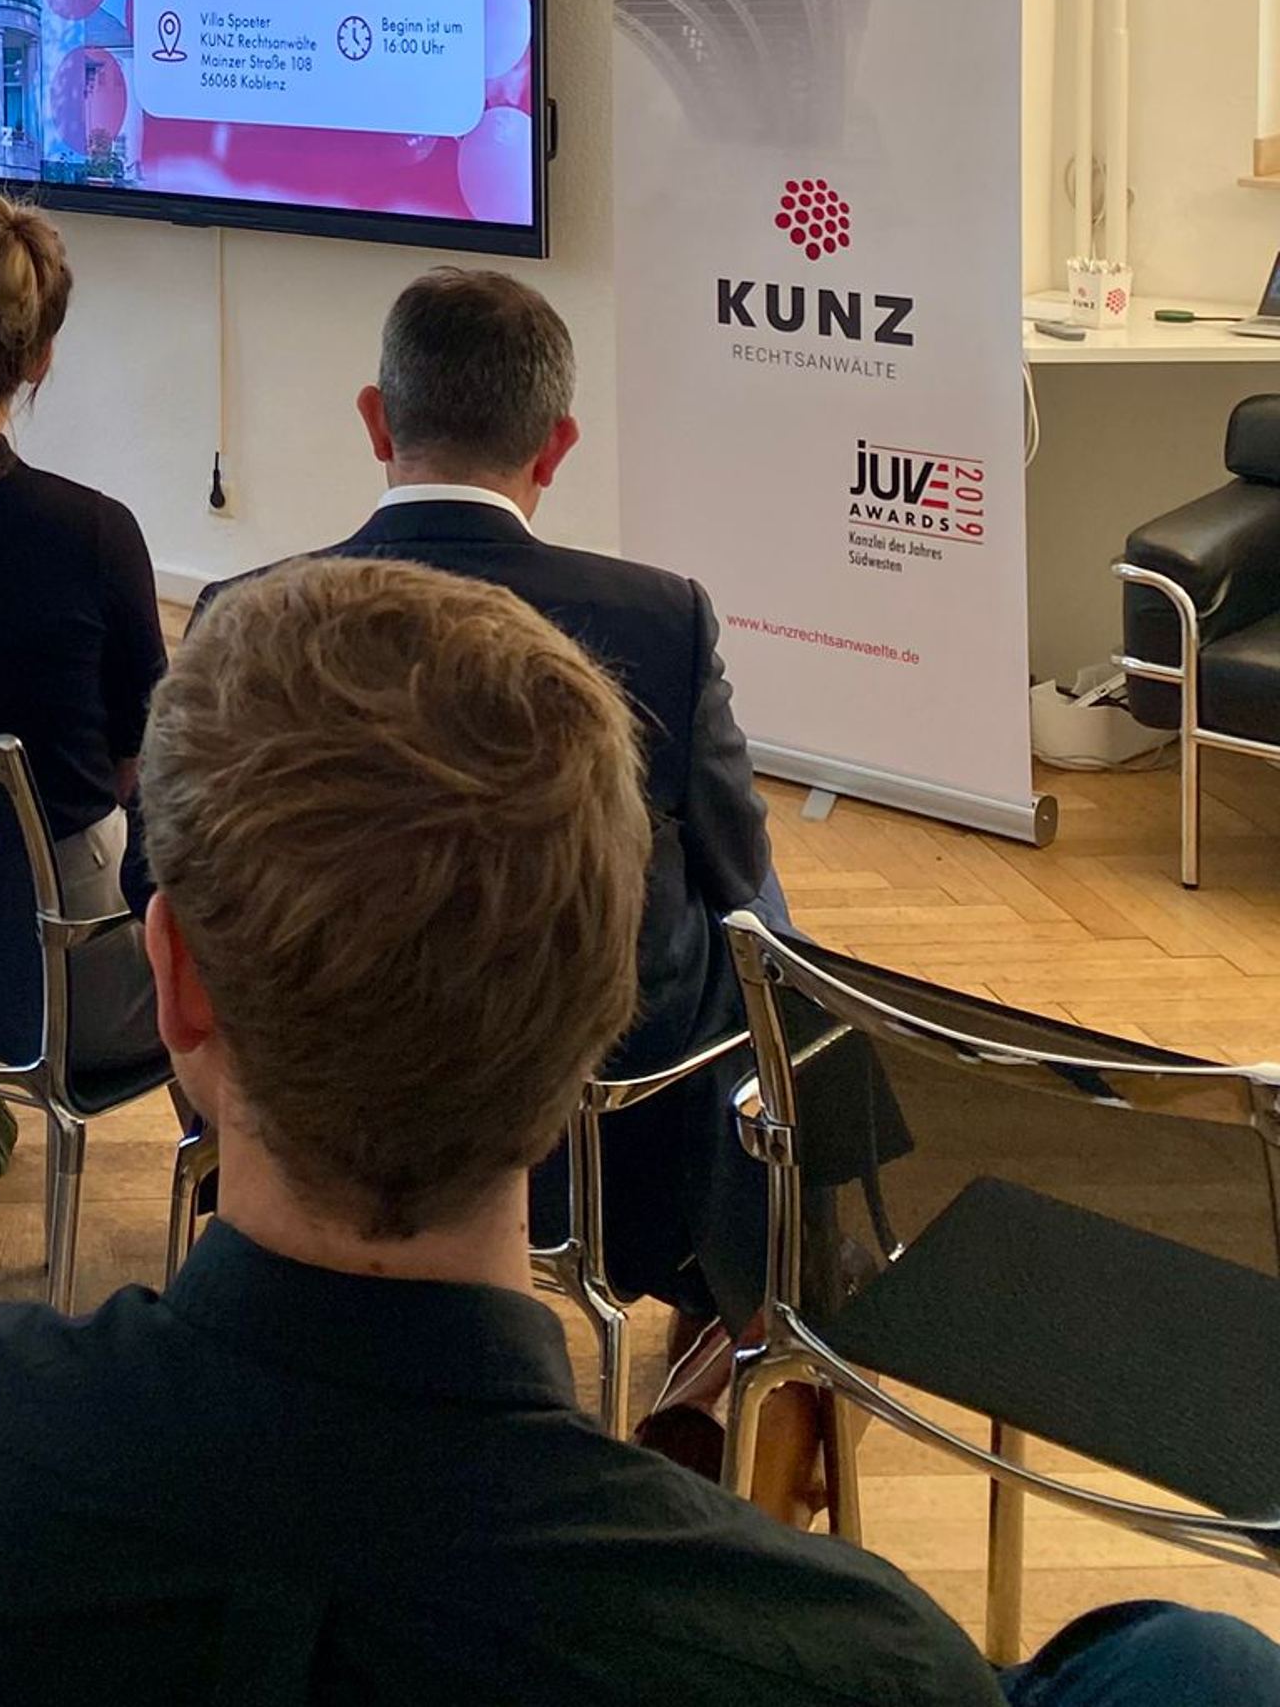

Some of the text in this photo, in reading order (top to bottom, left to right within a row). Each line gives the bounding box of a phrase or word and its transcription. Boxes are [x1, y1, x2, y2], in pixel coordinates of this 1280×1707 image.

[200, 12, 271, 31] Villa Spaeter
[381, 17, 463, 36] Beginn ist um
[200, 33, 318, 51] KUNZ Rechtsanwälte
[383, 38, 445, 54] 16:00 Uhr
[200, 54, 313, 71] Mainzer Straße 108
[200, 72, 287, 91] 56068 Koblenz
[717, 278, 914, 347] KUNZ
[954, 465, 984, 537] 2019
[849, 502, 950, 532] AWARDS
[848, 531, 943, 561] Kanzlei des Jahres
[848, 550, 903, 573] Südwesten
[726, 613, 920, 665] www.kunzrechtsanwaelte.de
